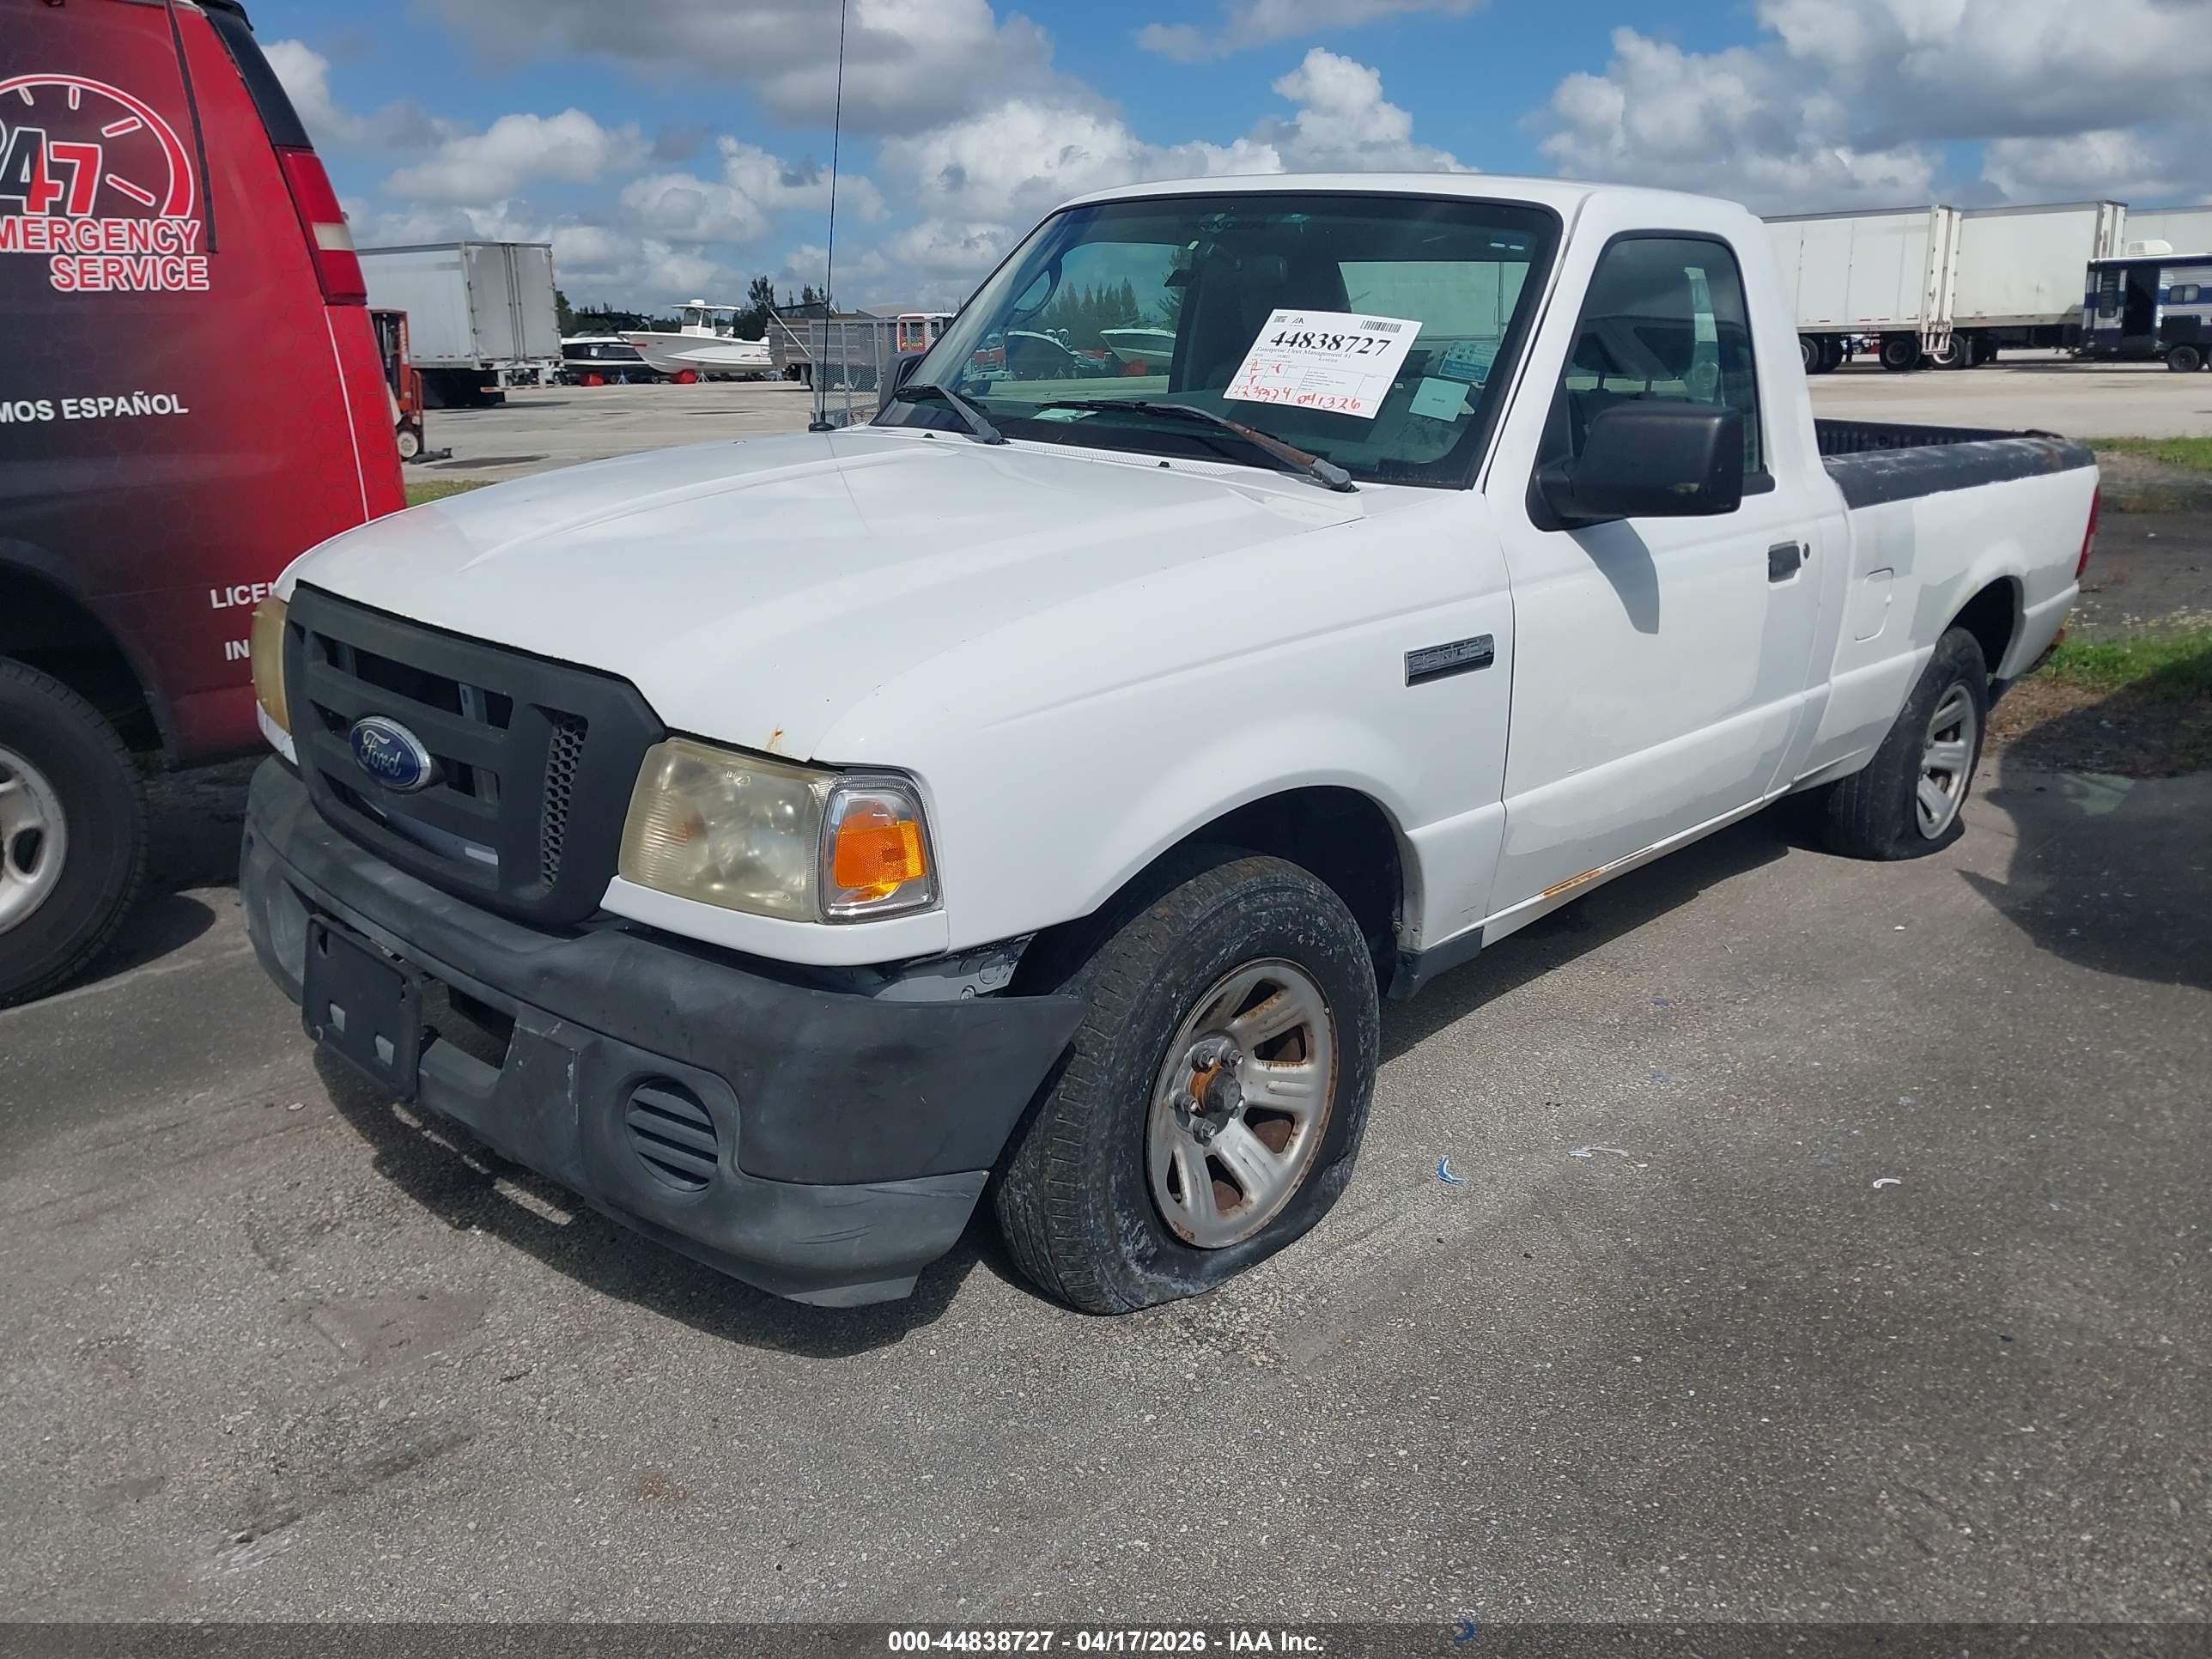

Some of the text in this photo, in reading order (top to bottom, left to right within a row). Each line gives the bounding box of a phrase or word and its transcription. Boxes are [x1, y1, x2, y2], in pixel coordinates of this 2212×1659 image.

[50, 254, 210, 292] SERVICE
[1271, 331, 1392, 356] 44838727
[1304, 349, 1342, 358] Management
[61, 391, 190, 420] ESPAÑOL
[361, 730, 402, 776] Ford
